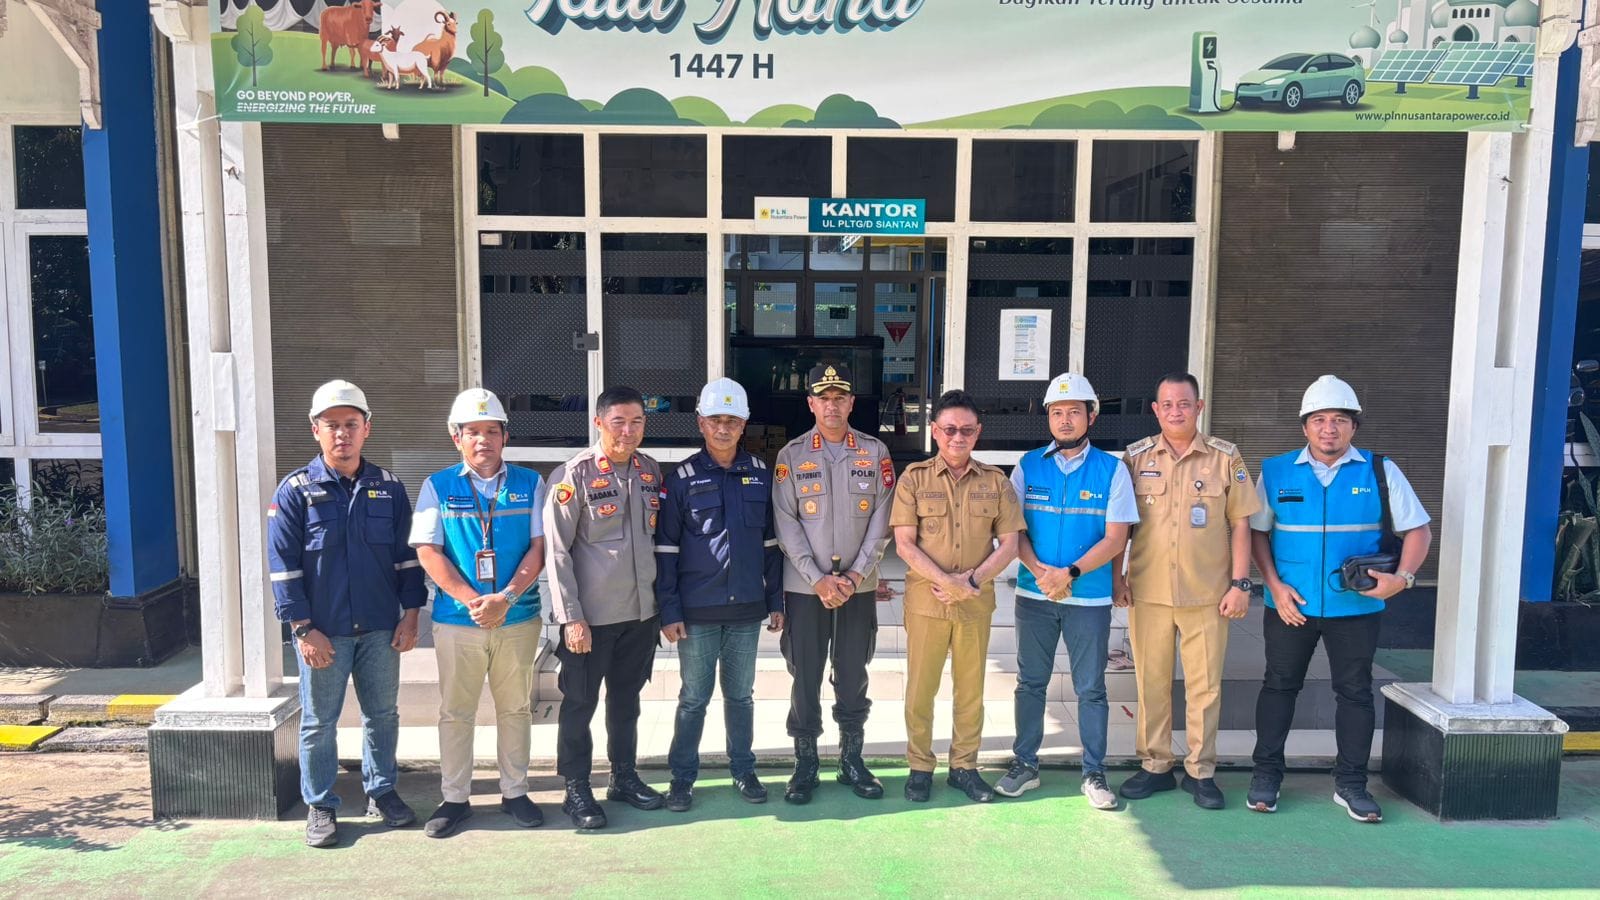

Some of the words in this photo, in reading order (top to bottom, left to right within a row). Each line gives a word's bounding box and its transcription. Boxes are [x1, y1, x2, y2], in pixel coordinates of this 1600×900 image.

[669, 53, 744, 78] 1447
[753, 53, 774, 79] H
[236, 90, 255, 100] GO
[257, 90, 307, 101] BEYOND
[309, 91, 355, 103] POWER,
[236, 102, 307, 113] ENERGIZING
[309, 103, 330, 113] THE
[332, 104, 376, 114] FUTURE
[1355, 111, 1510, 122] www.plnnusantarapower.co.id
[821, 203, 917, 217] KANTOR
[822, 219, 836, 228] UL
[838, 219, 873, 229] PLTG/D
[875, 220, 919, 229] SIANTAN
[851, 469, 875, 478] POLRI
